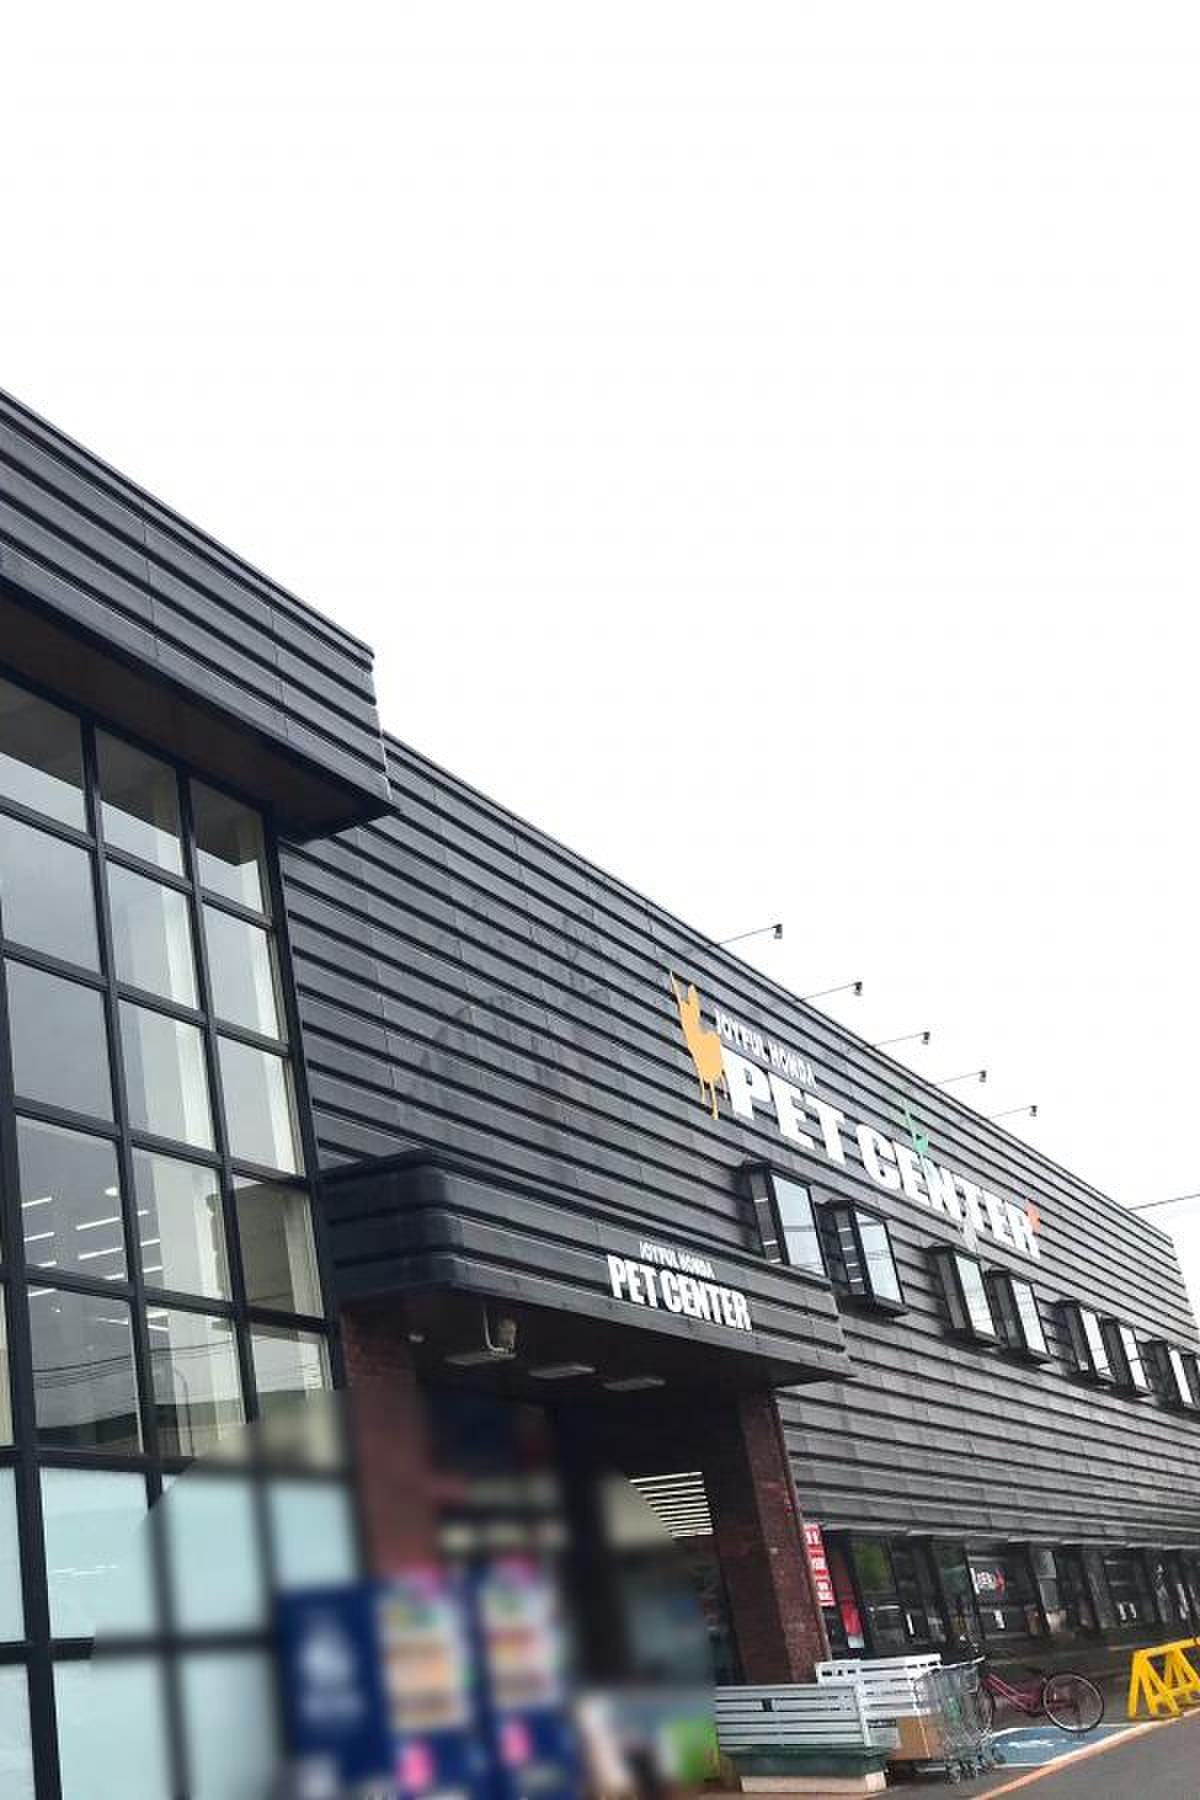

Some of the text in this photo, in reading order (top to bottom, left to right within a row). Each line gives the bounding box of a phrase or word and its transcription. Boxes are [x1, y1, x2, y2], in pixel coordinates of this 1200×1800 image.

[714, 1008, 770, 1062] JOYFUL
[720, 1044, 1040, 1259] PET CENTER
[608, 1254, 752, 1331] PET CENTER
